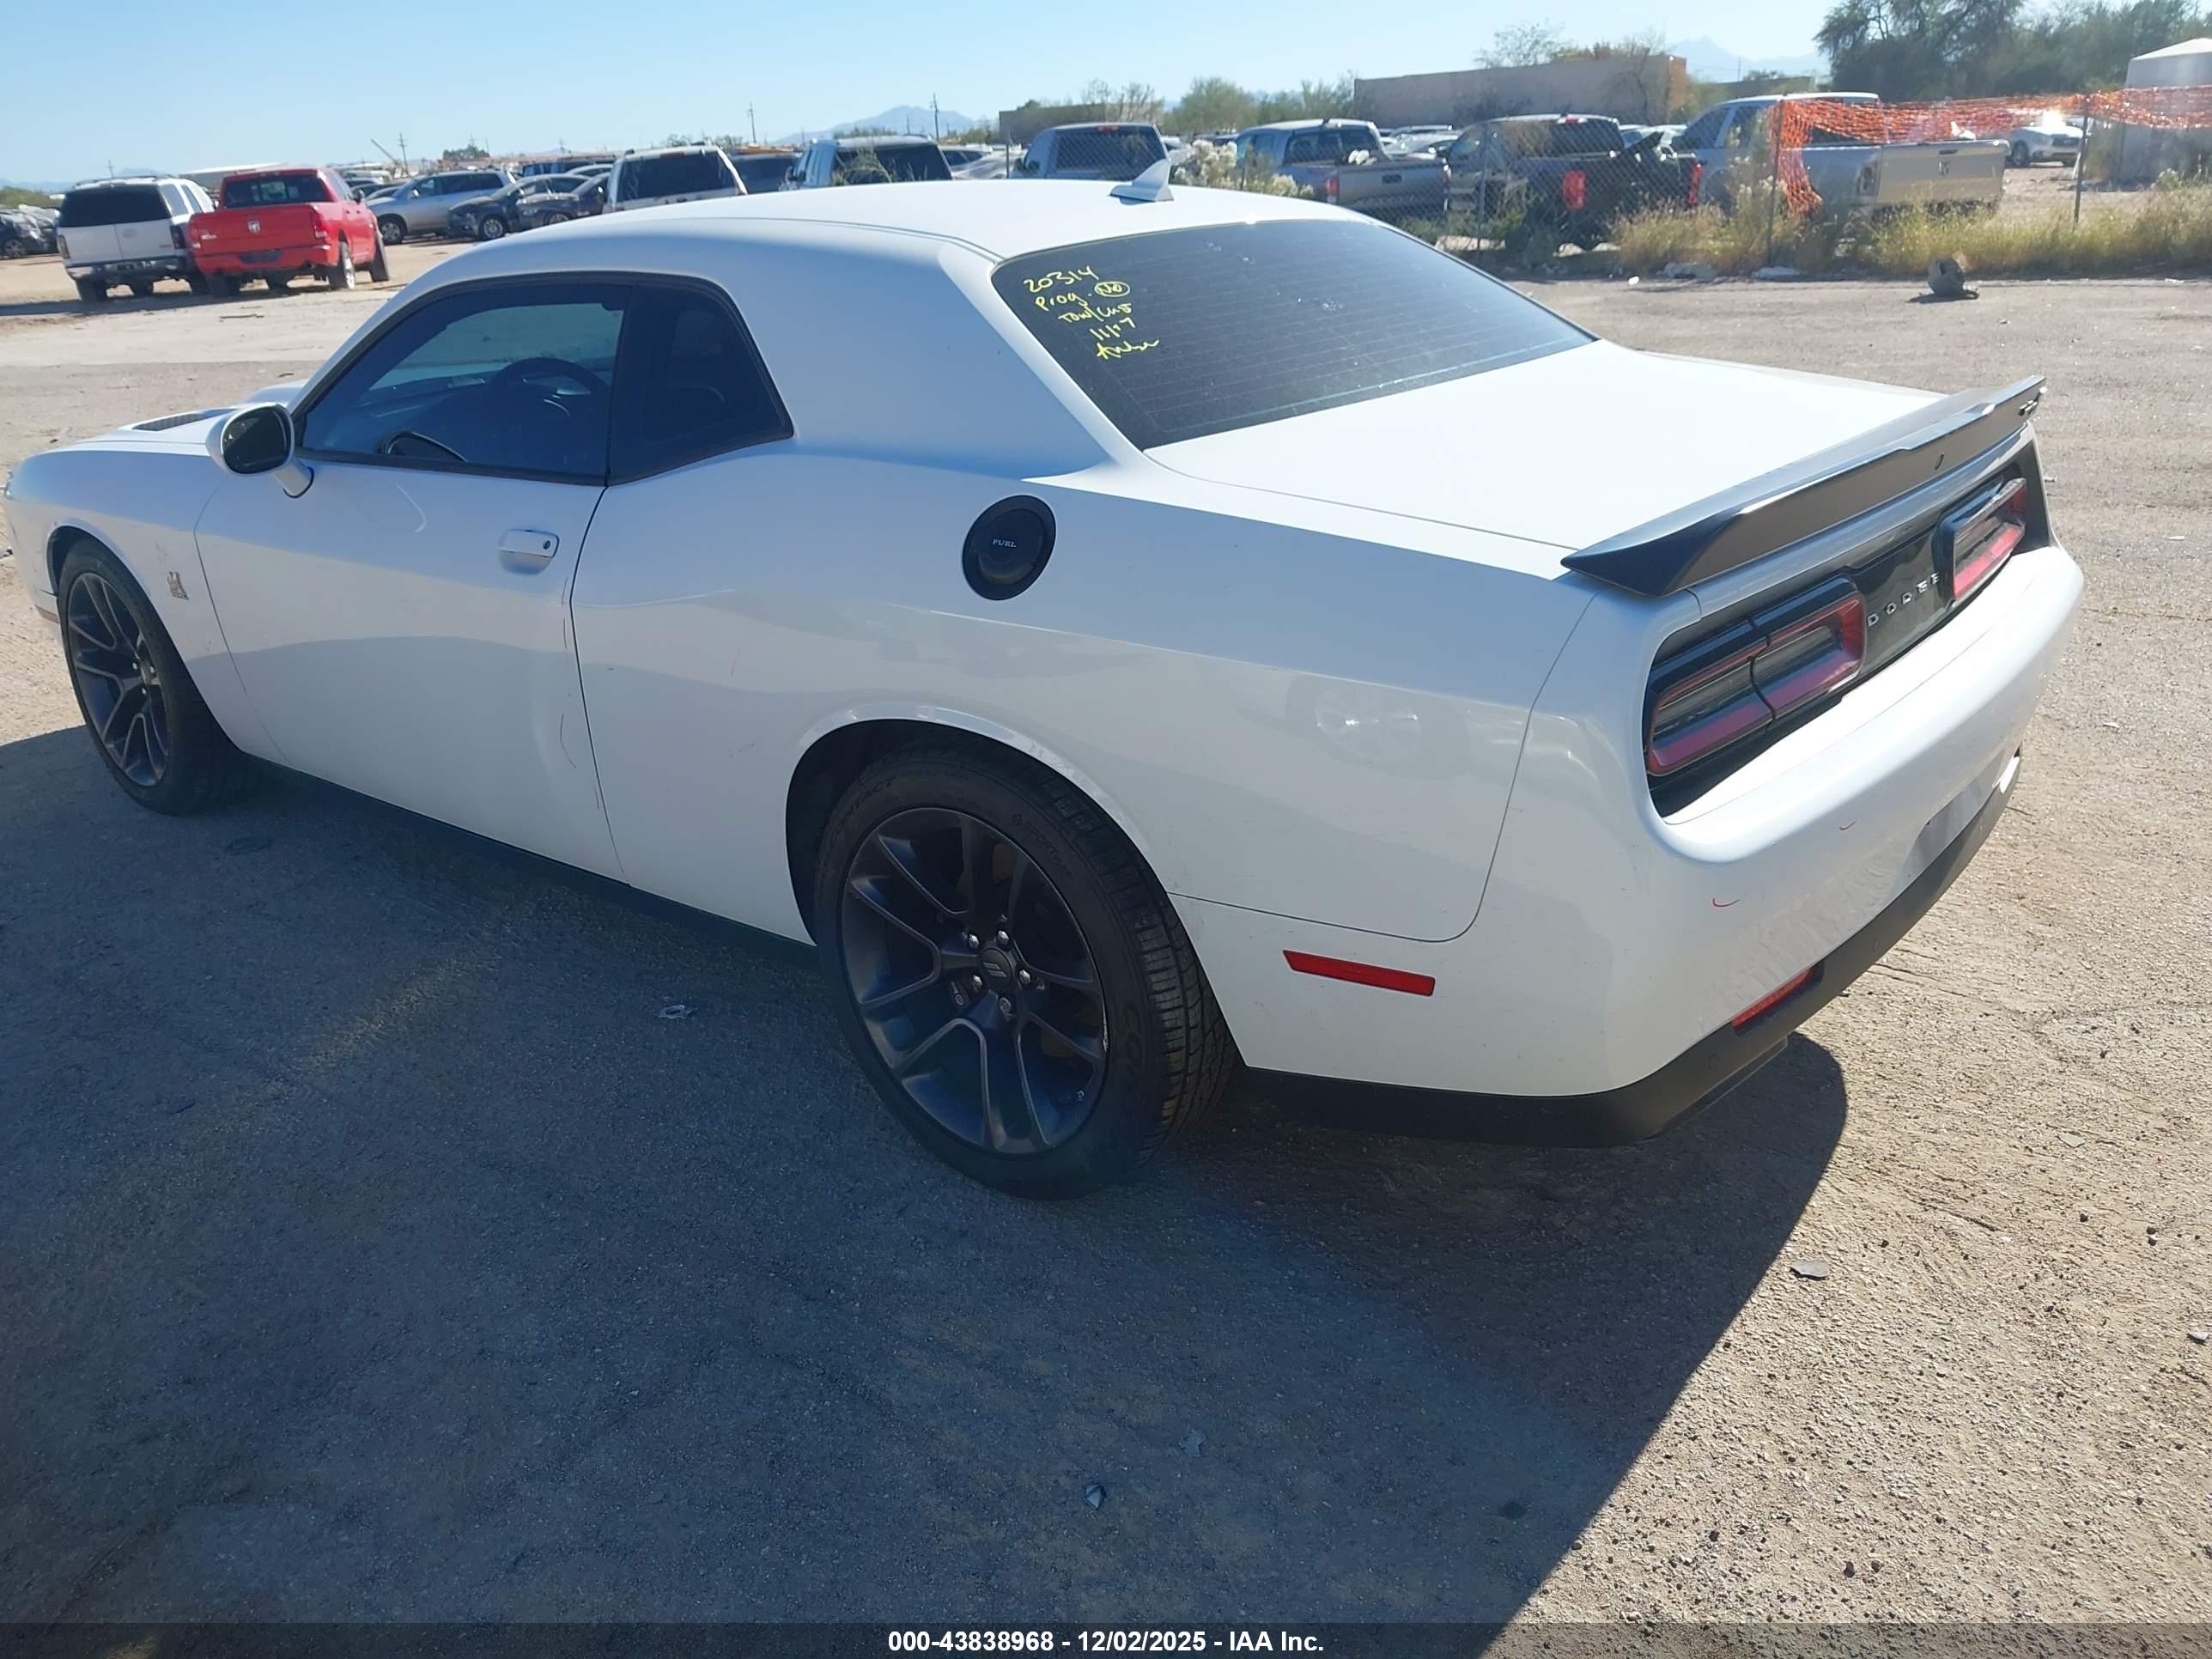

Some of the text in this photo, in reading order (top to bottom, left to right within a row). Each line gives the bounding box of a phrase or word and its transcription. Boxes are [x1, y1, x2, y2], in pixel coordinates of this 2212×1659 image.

[1024, 265, 1099, 293] 20314
[992, 538, 1018, 548] FUEL
[1867, 572, 1940, 627] DODGE
